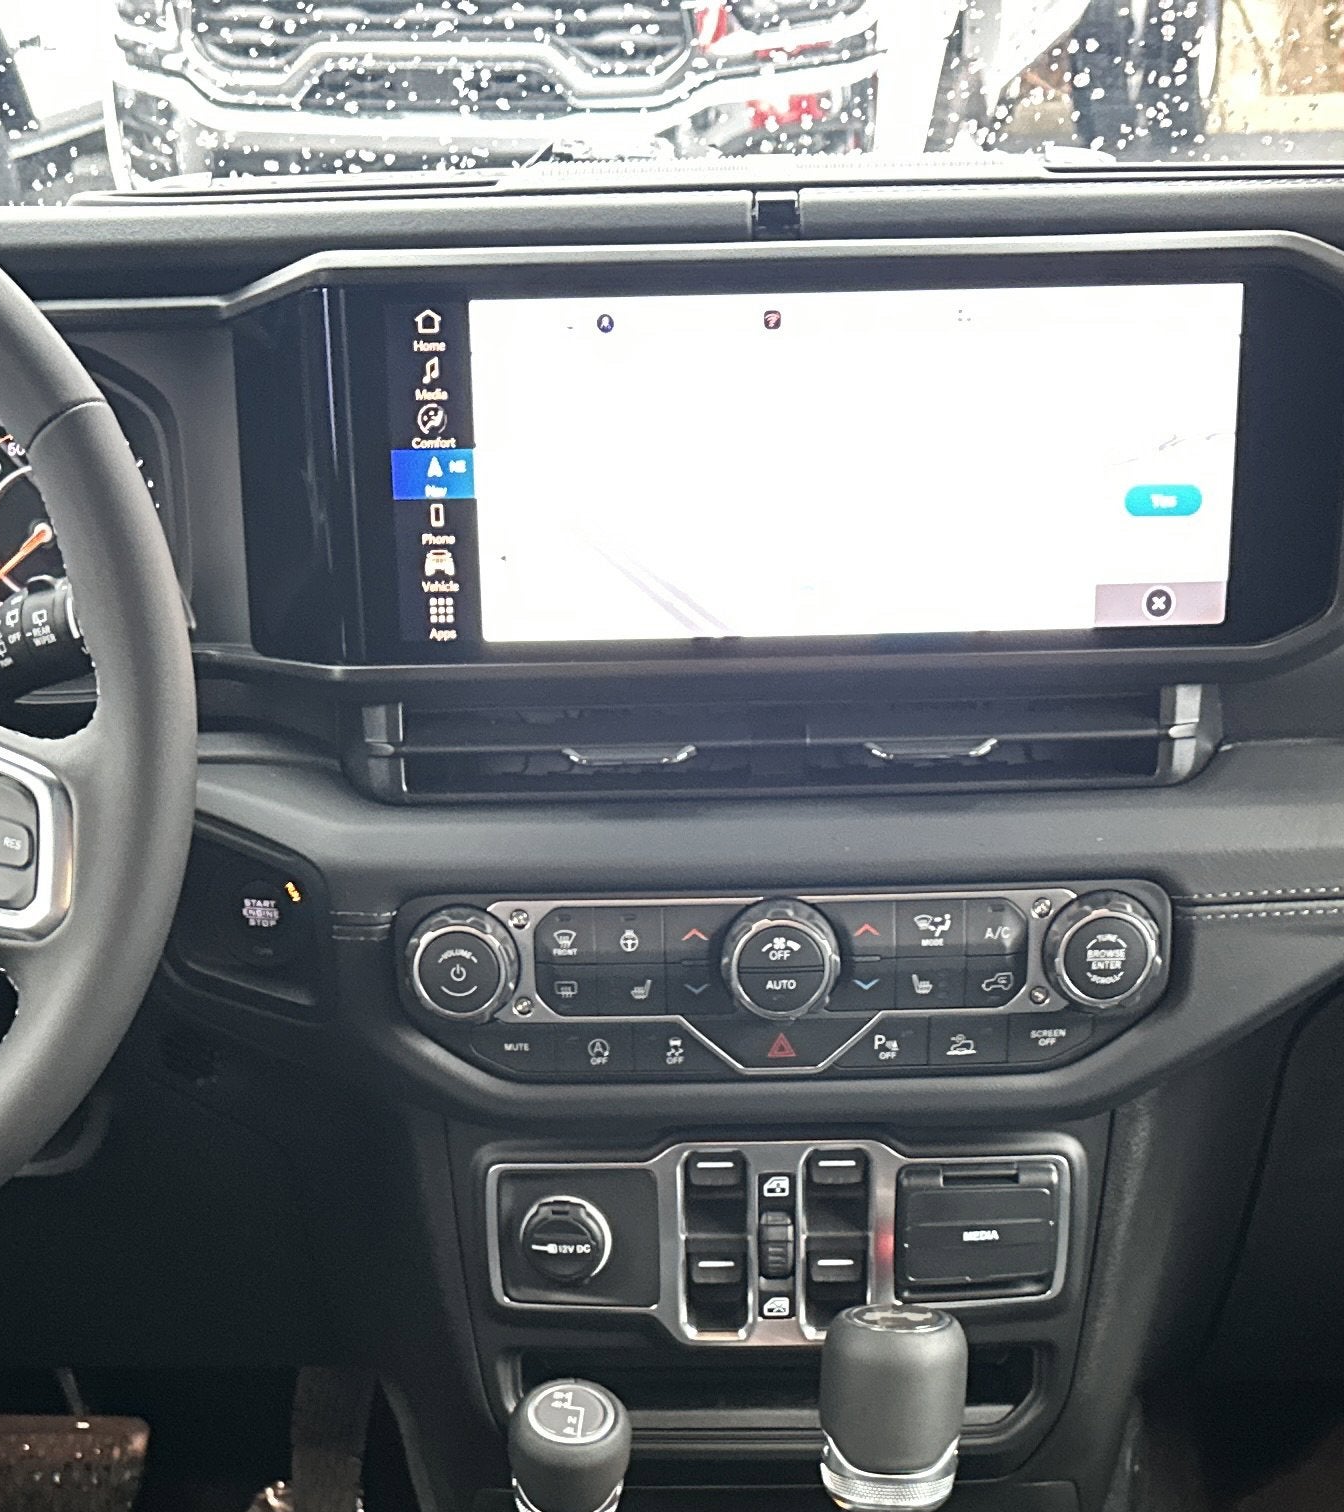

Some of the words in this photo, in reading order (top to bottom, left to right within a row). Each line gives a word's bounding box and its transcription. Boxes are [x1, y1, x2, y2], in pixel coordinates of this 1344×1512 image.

[413, 340, 446, 352] Home
[411, 436, 457, 449] Comfort
[421, 533, 456, 545] Phone
[421, 580, 460, 593] Vehicle
[429, 628, 457, 642] Apps
[3, 835, 22, 851] RES
[243, 898, 277, 908] START
[985, 926, 1011, 940] A/C
[921, 937, 944, 946] MODE
[768, 950, 791, 960] OFF
[1087, 949, 1126, 958] BROWSE
[1091, 960, 1123, 970] ENTER
[765, 979, 797, 990] AUTO
[1030, 1028, 1067, 1039] SCREEN
[504, 1042, 529, 1052] MUTE
[1038, 1038, 1056, 1047] OFF
[590, 1056, 608, 1066] OFF
[666, 1055, 684, 1066] OFF
[878, 1050, 898, 1061] OFF
[962, 1229, 1000, 1242] MEDIA
[576, 1244, 591, 1254] DC
